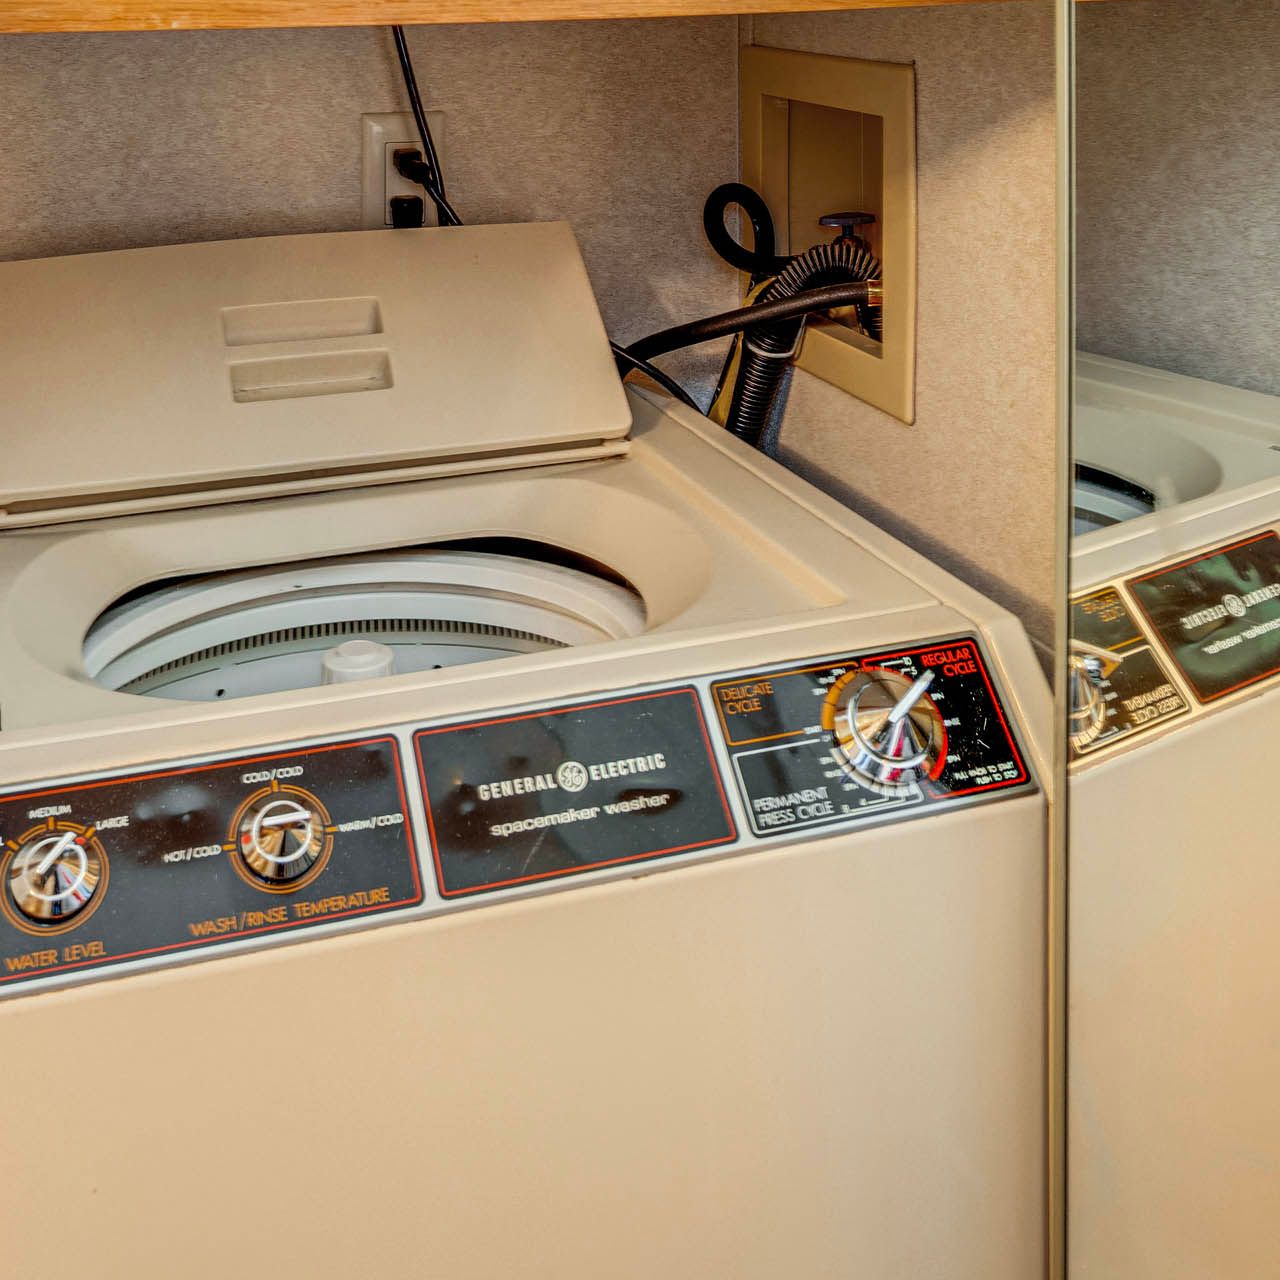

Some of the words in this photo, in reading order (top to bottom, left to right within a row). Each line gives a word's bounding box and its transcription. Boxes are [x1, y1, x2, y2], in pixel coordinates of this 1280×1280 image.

[921, 647, 972, 667] REGULAR
[943, 660, 977, 677] CYCLE
[720, 681, 774, 701] DELICATE
[726, 698, 762, 715] CYCLE
[242, 765, 303, 784] COLD/COLD
[478, 773, 558, 801] GENERAL
[588, 753, 666, 781] ELECTRIC
[753, 786, 829, 812] PERMANENT
[29, 804, 72, 819] MEDIUM
[489, 806, 601, 837] spacemaker
[602, 793, 670, 815] washer
[757, 808, 796, 827] PRESS
[796, 801, 835, 819] CYCLE
[95, 816, 130, 830] LARGE
[338, 813, 404, 833] WARM/COLD
[163, 844, 222, 863] HOT/COLD
[293, 887, 391, 917] TEMPERATURE
[4, 949, 58, 971] WATER
[63, 940, 106, 962] LEVEL
